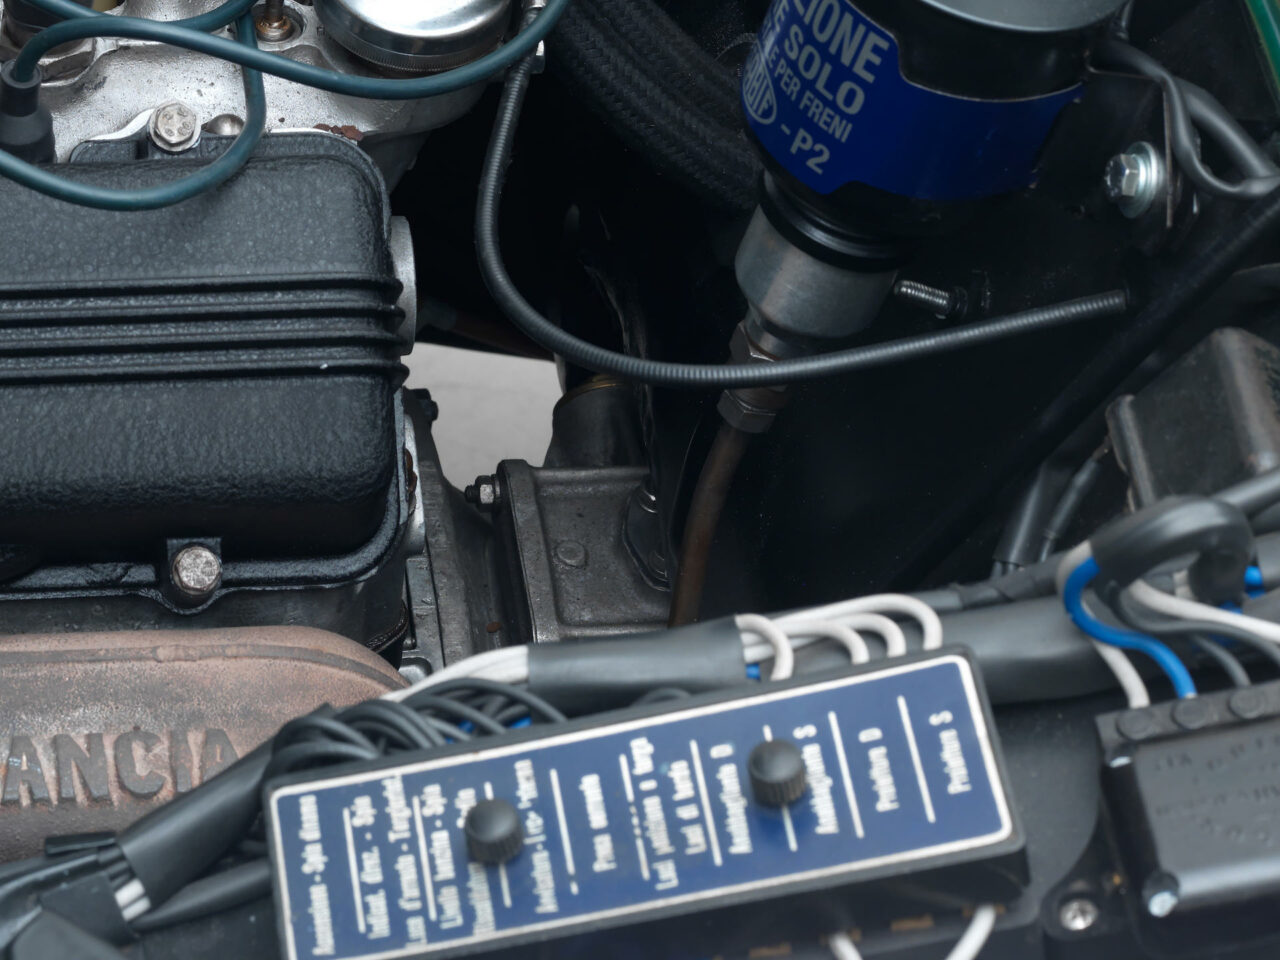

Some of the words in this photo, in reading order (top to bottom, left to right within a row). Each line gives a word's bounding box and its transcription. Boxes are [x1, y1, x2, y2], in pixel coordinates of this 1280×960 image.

[784, 25, 865, 115] SOLO
[774, 57, 799, 103] PER
[798, 93, 853, 143] FRENI
[790, 129, 832, 175] P2
[792, 725, 817, 739] S
[928, 710, 953, 726] S
[858, 727, 883, 743] D
